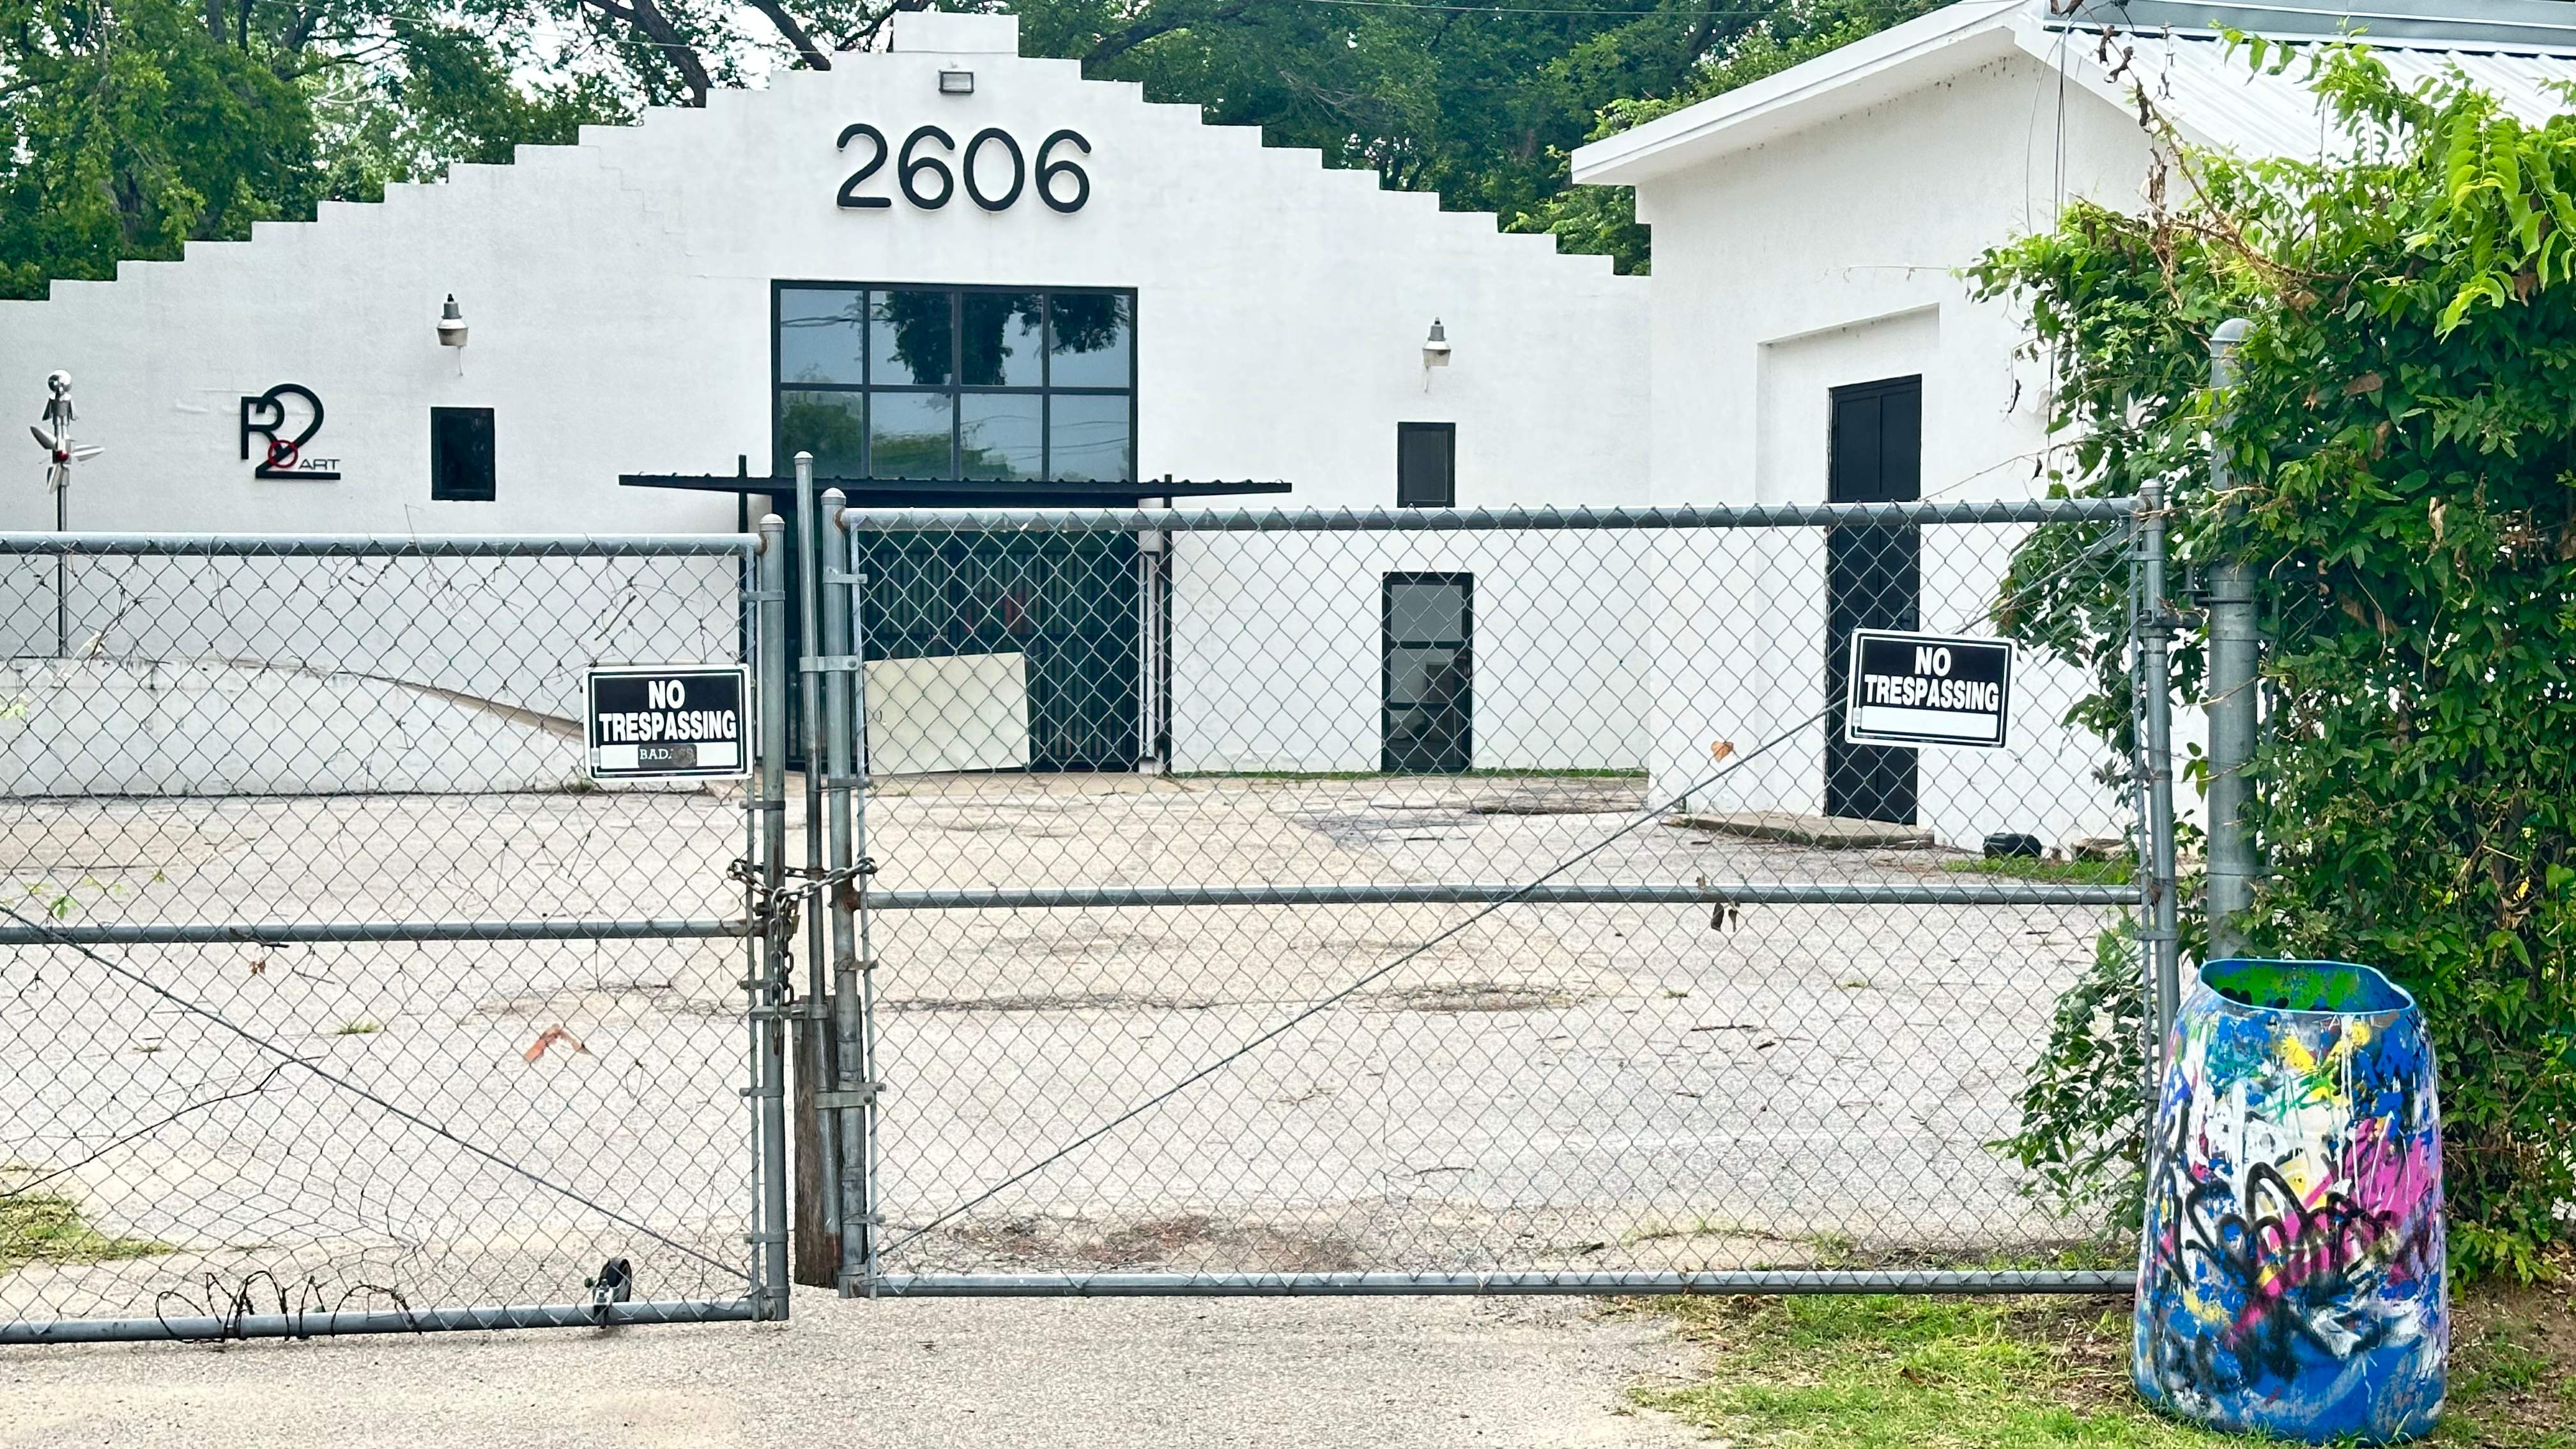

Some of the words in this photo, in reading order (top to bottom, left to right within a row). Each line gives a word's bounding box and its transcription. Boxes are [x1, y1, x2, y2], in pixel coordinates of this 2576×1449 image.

[836, 123, 1091, 213] 2606
[299, 459, 341, 470] ART
[1915, 646, 1951, 677] NO
[648, 679, 686, 709] NO
[1864, 674, 1999, 712] TRESPASSING
[599, 710, 737, 741] TRESPASSING
